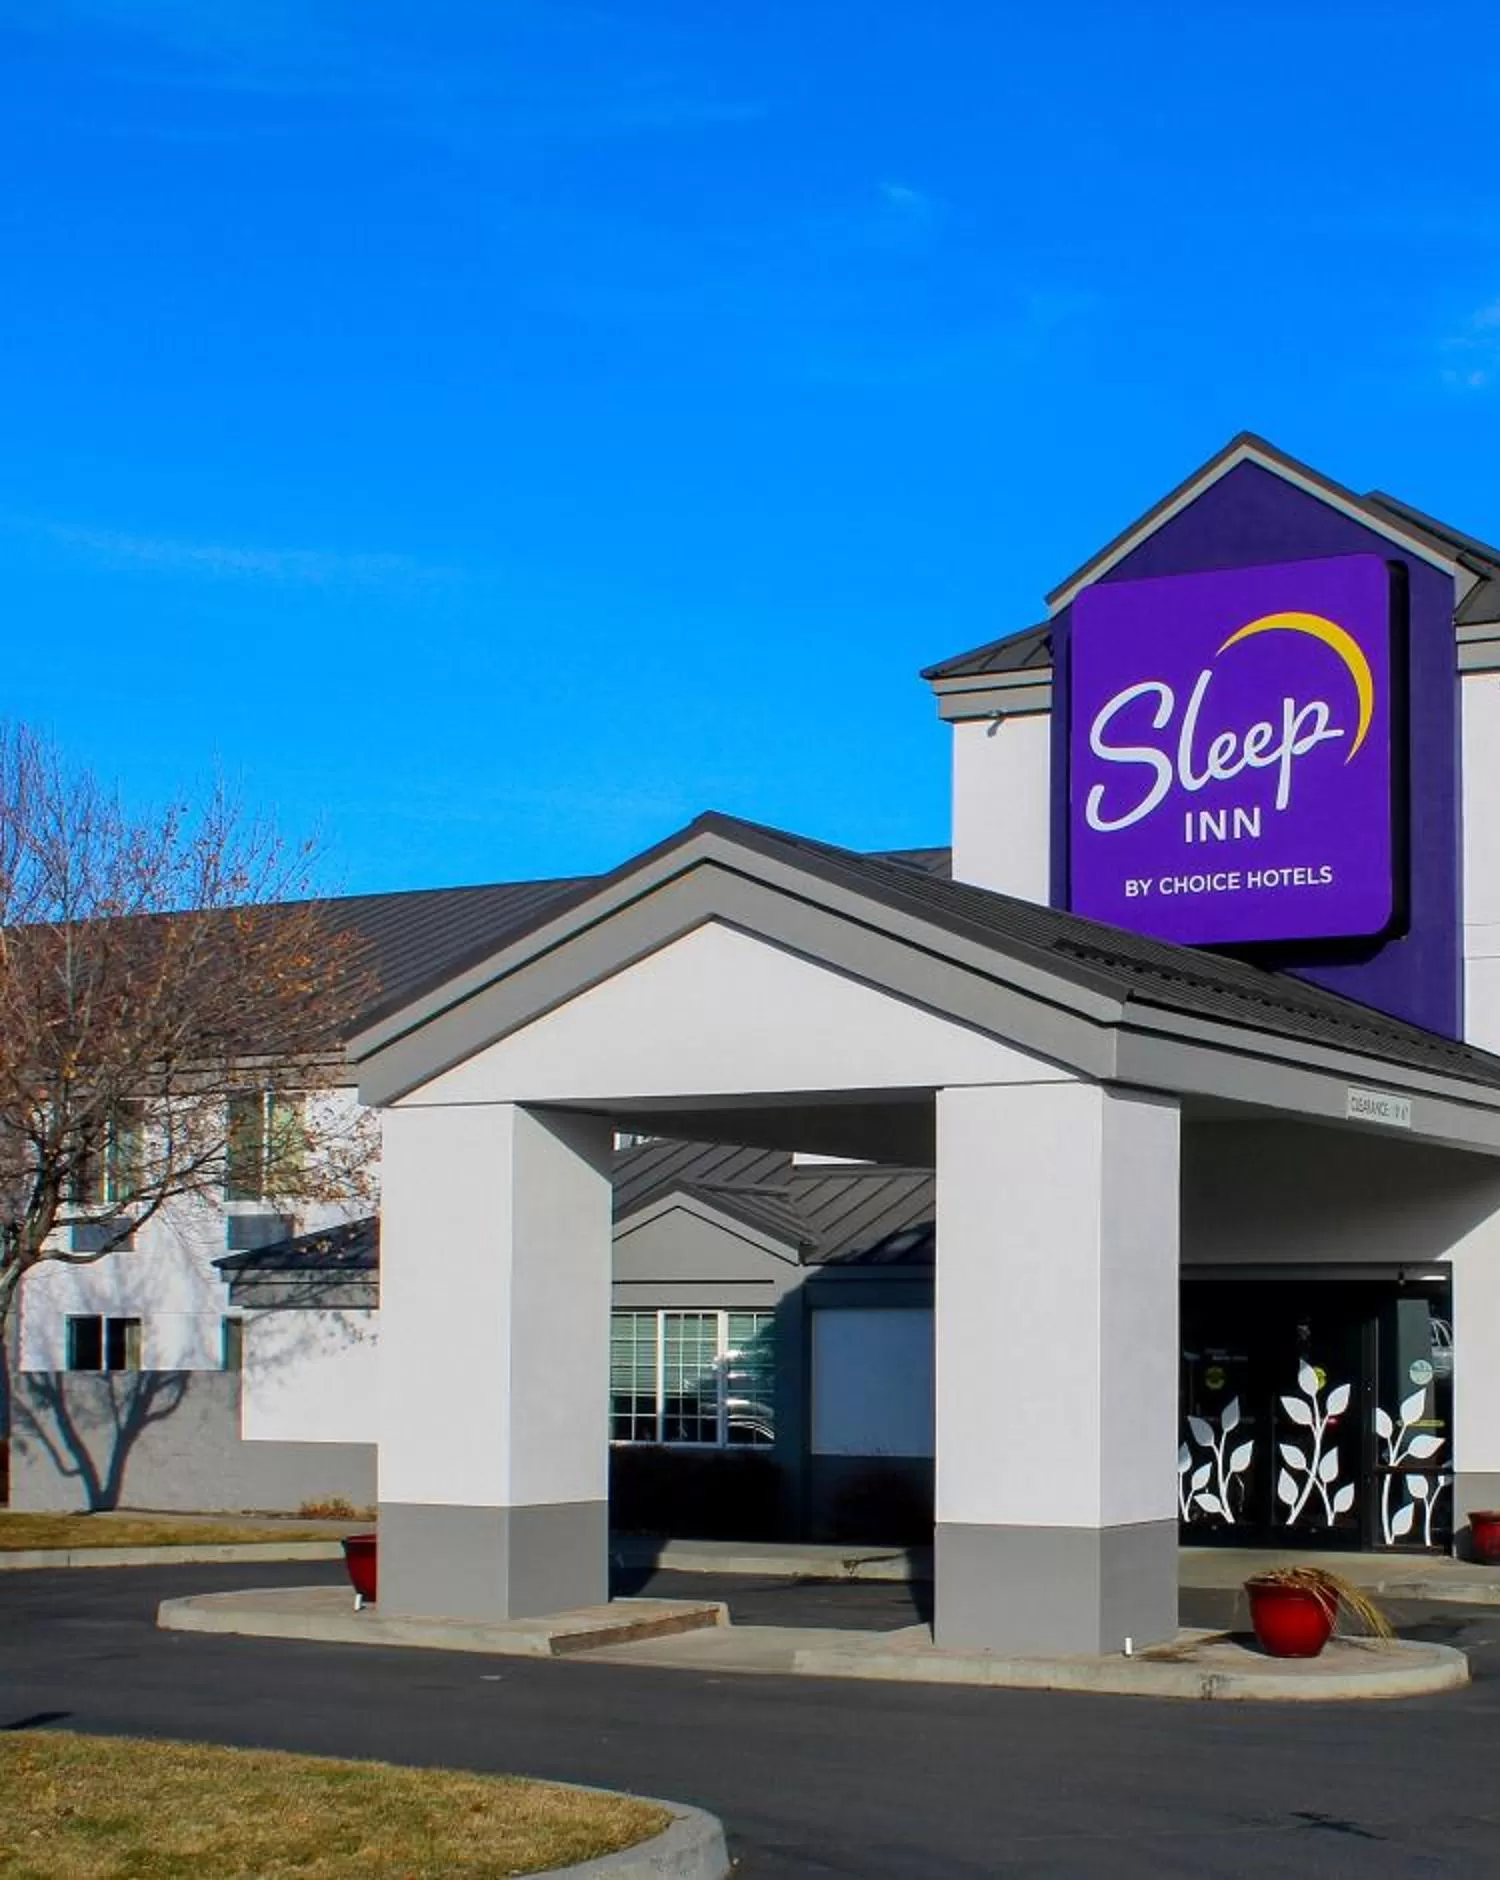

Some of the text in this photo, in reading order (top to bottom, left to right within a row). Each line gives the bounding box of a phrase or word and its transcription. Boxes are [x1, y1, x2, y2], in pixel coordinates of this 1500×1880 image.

[1086, 669, 1344, 832] Sleep
[1185, 806, 1261, 842] INN
[1126, 865, 1333, 896] BY CHOICE HOTELS
